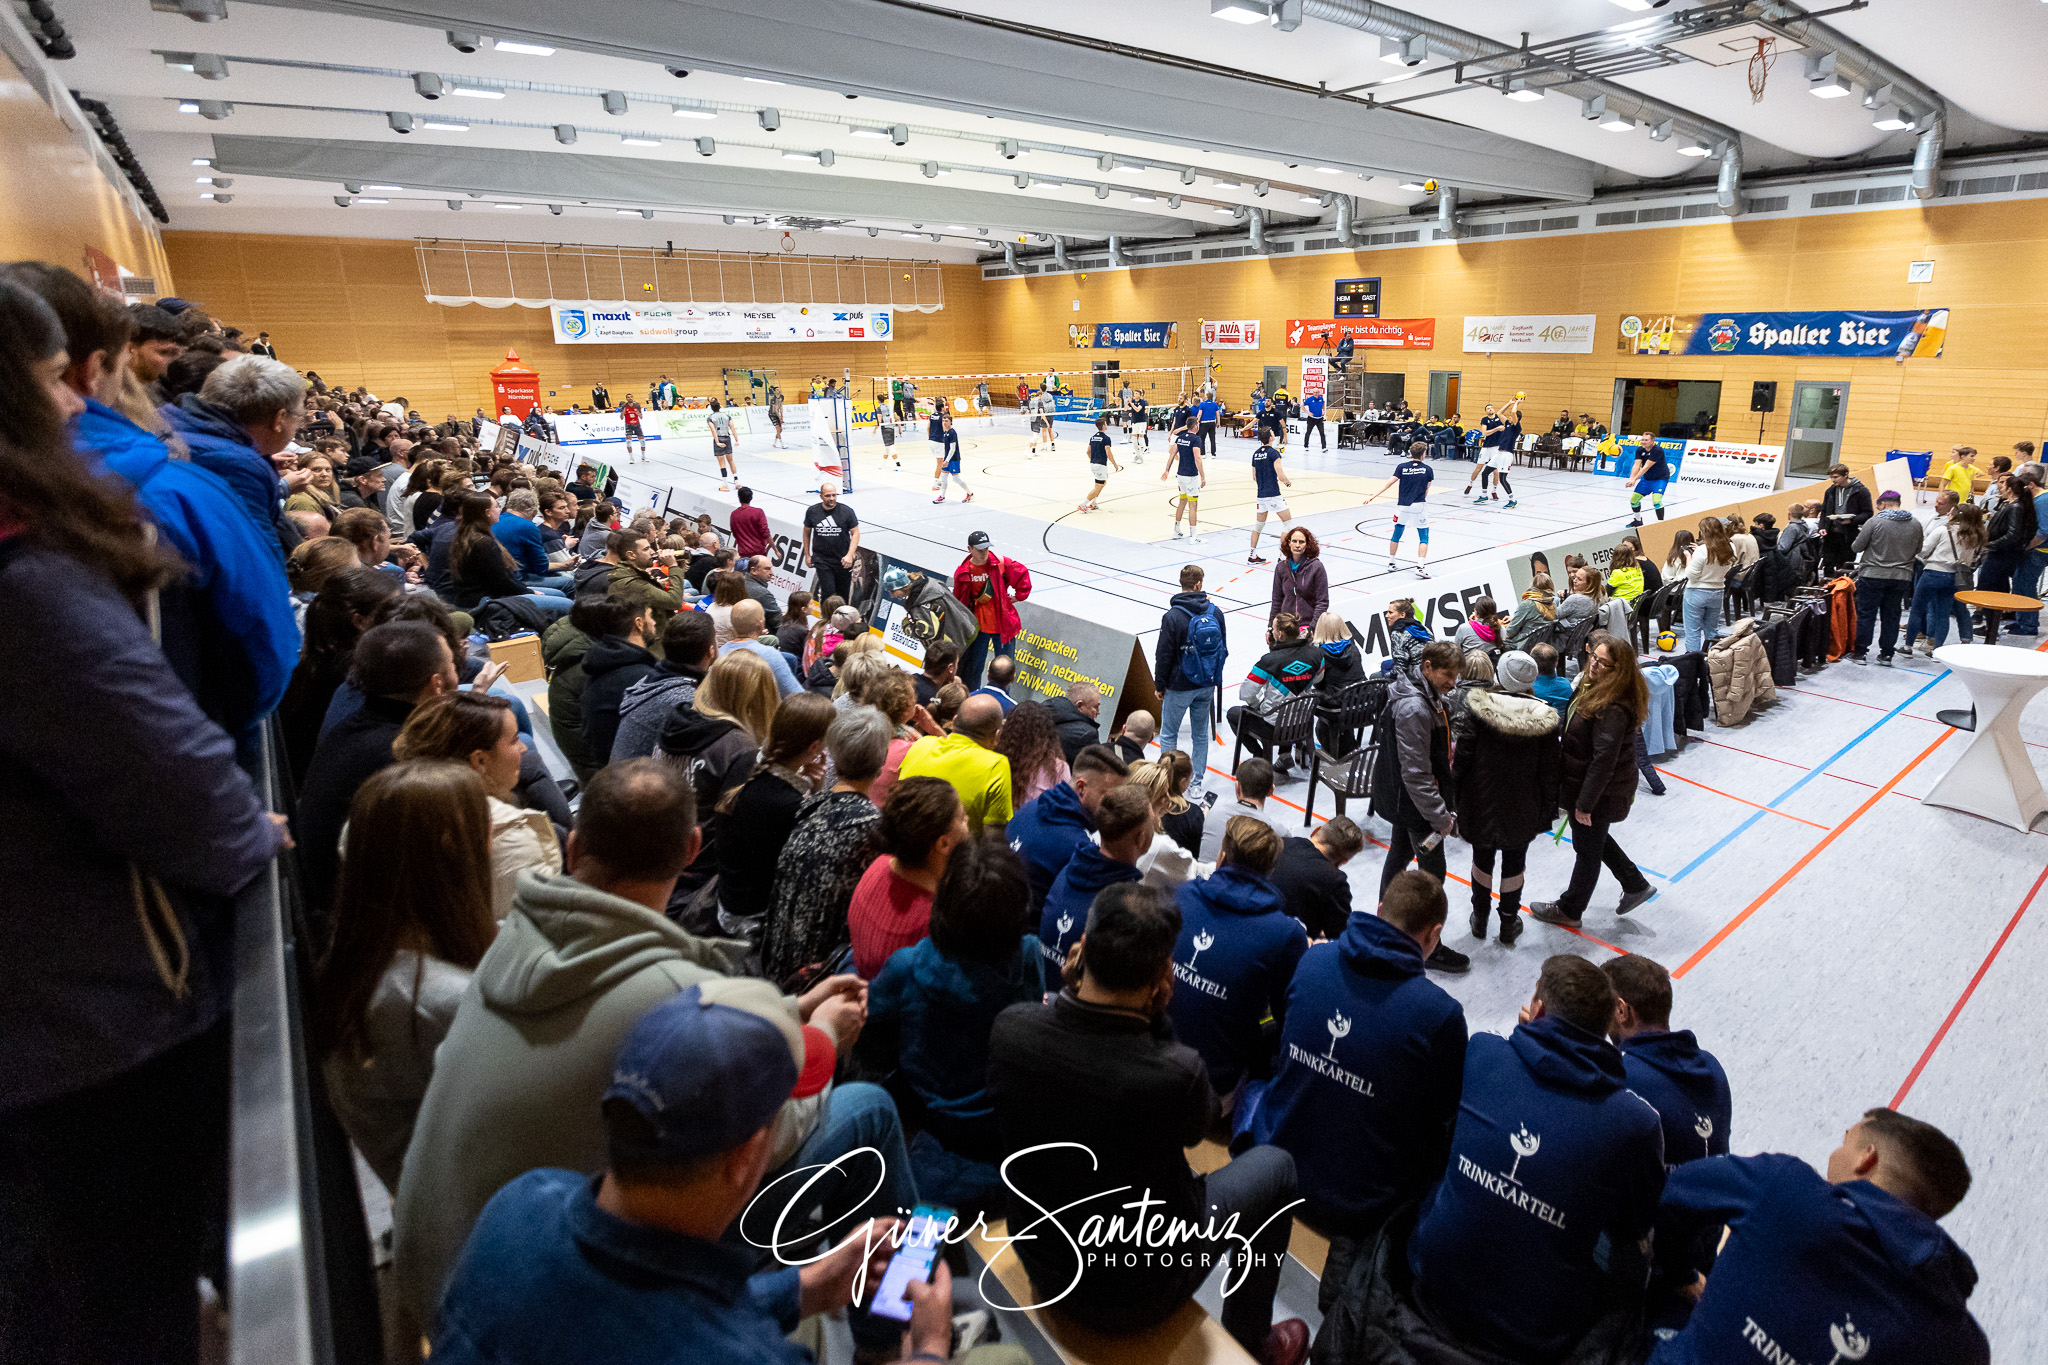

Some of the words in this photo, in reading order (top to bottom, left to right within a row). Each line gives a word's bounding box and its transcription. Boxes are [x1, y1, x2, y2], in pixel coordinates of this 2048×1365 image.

[592, 311, 631, 321] maxit
[1113, 327, 1142, 344] Spalter
[1143, 327, 1161, 342] Bier
[1306, 322, 1337, 332] Teamplayer
[1340, 325, 1354, 334] Hier
[1355, 326, 1368, 334] bist
[1369, 326, 1379, 334] du
[1380, 325, 1404, 337] richtig.
[1746, 320, 1830, 350] Spalter
[1837, 321, 1891, 347] Bier
[507, 387, 534, 395] Sparkasse
[591, 424, 625, 434] volleyba
[1660, 440, 1683, 450] NETZ!
[1687, 445, 1778, 465] schweiger
[1680, 474, 1771, 490] www.schweiger.de
[770, 573, 803, 592] etechnik
[891, 632, 919, 651] SERVICES
[1026, 632, 1079, 663] anpacken,
[1288, 1042, 1375, 1099] TRINKKARTELL
[1457, 1153, 1567, 1230] TRINKKARTELL
